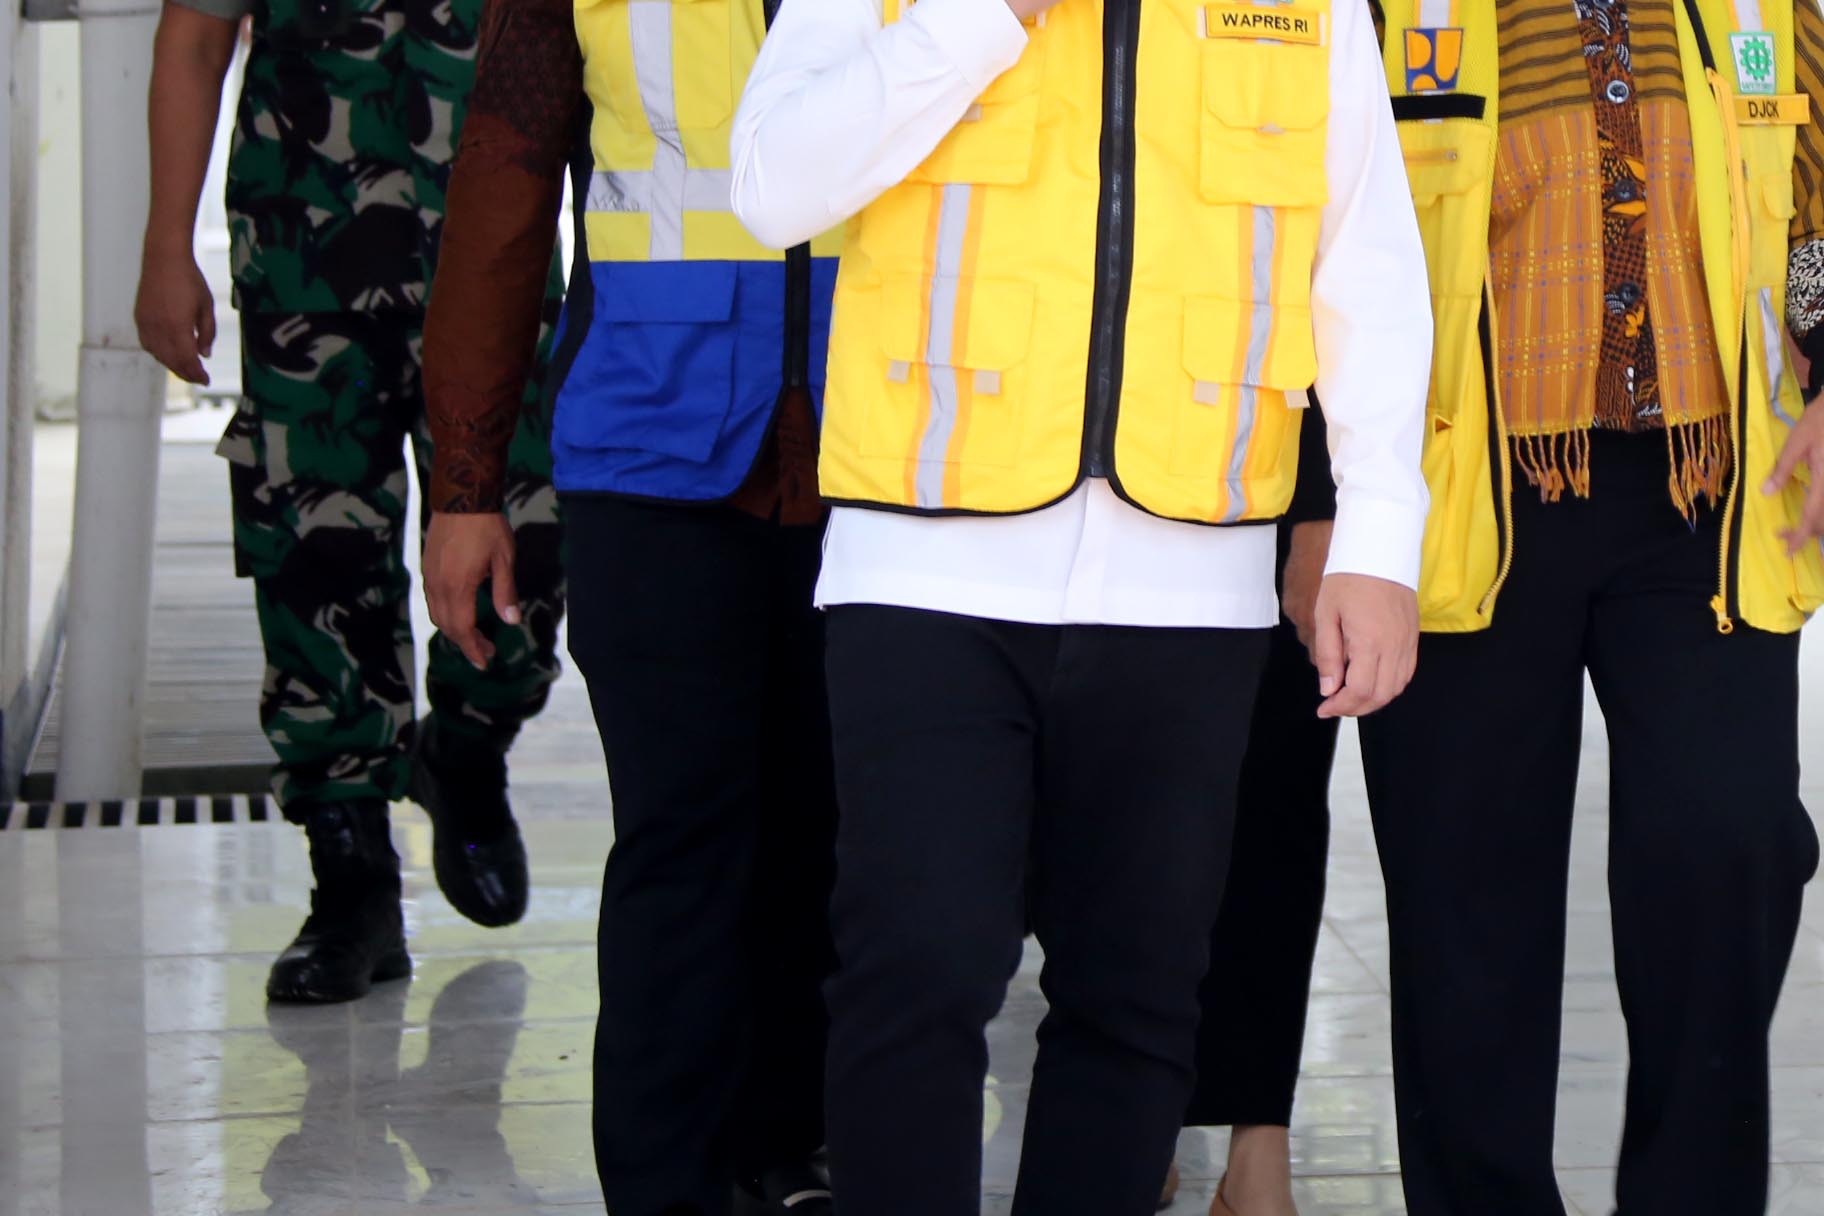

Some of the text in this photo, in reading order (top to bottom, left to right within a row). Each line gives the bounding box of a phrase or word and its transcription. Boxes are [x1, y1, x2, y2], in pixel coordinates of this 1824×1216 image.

[1222, 13, 1307, 32] WAPRES RI
[1748, 100, 1779, 118] DJCK
